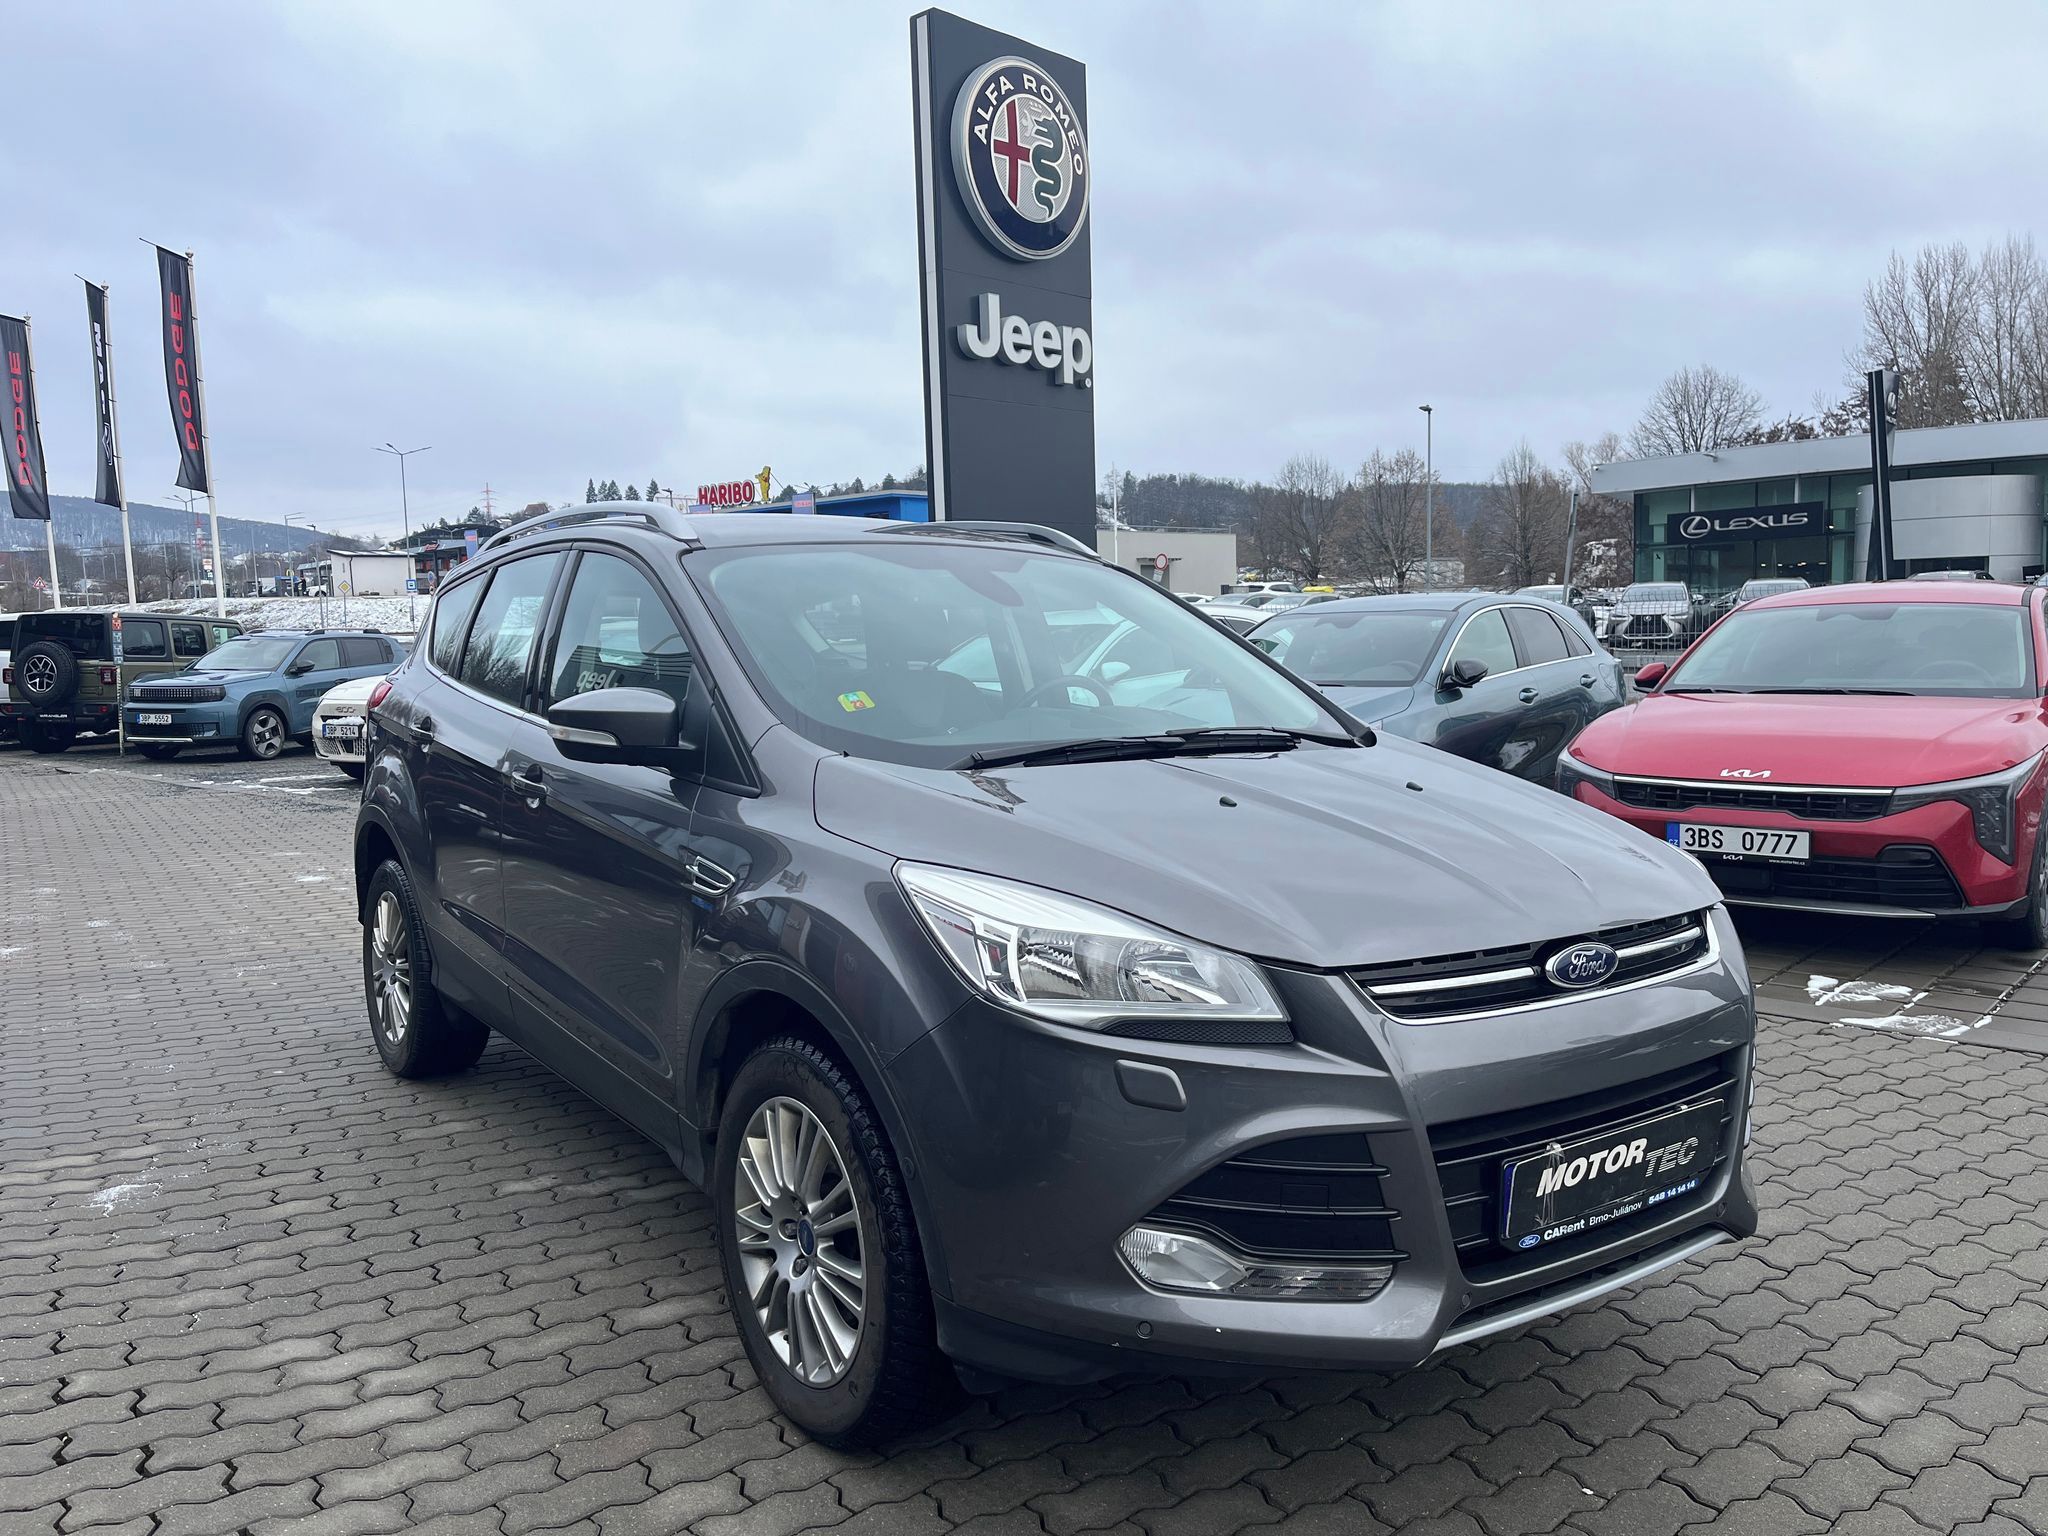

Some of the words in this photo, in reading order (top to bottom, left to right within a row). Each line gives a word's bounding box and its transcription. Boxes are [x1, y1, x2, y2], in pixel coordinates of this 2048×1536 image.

[974, 75, 1015, 145] ALFA
[1023, 73, 1083, 176] ROMEO
[957, 293, 1092, 385] Jeep
[170, 291, 199, 451] DODGE
[8, 351, 33, 486] DODGE
[698, 480, 755, 506] HARIBO
[1714, 512, 1808, 531] LEXUS
[340, 726, 356, 736] 5214
[1720, 768, 1771, 778] KIA
[1684, 827, 1724, 849] 3BS
[1742, 831, 1798, 855] 0777
[1569, 949, 1607, 978] Ford
[1544, 1219, 1585, 1240] CARent
[1648, 1191, 1666, 1205] 548
